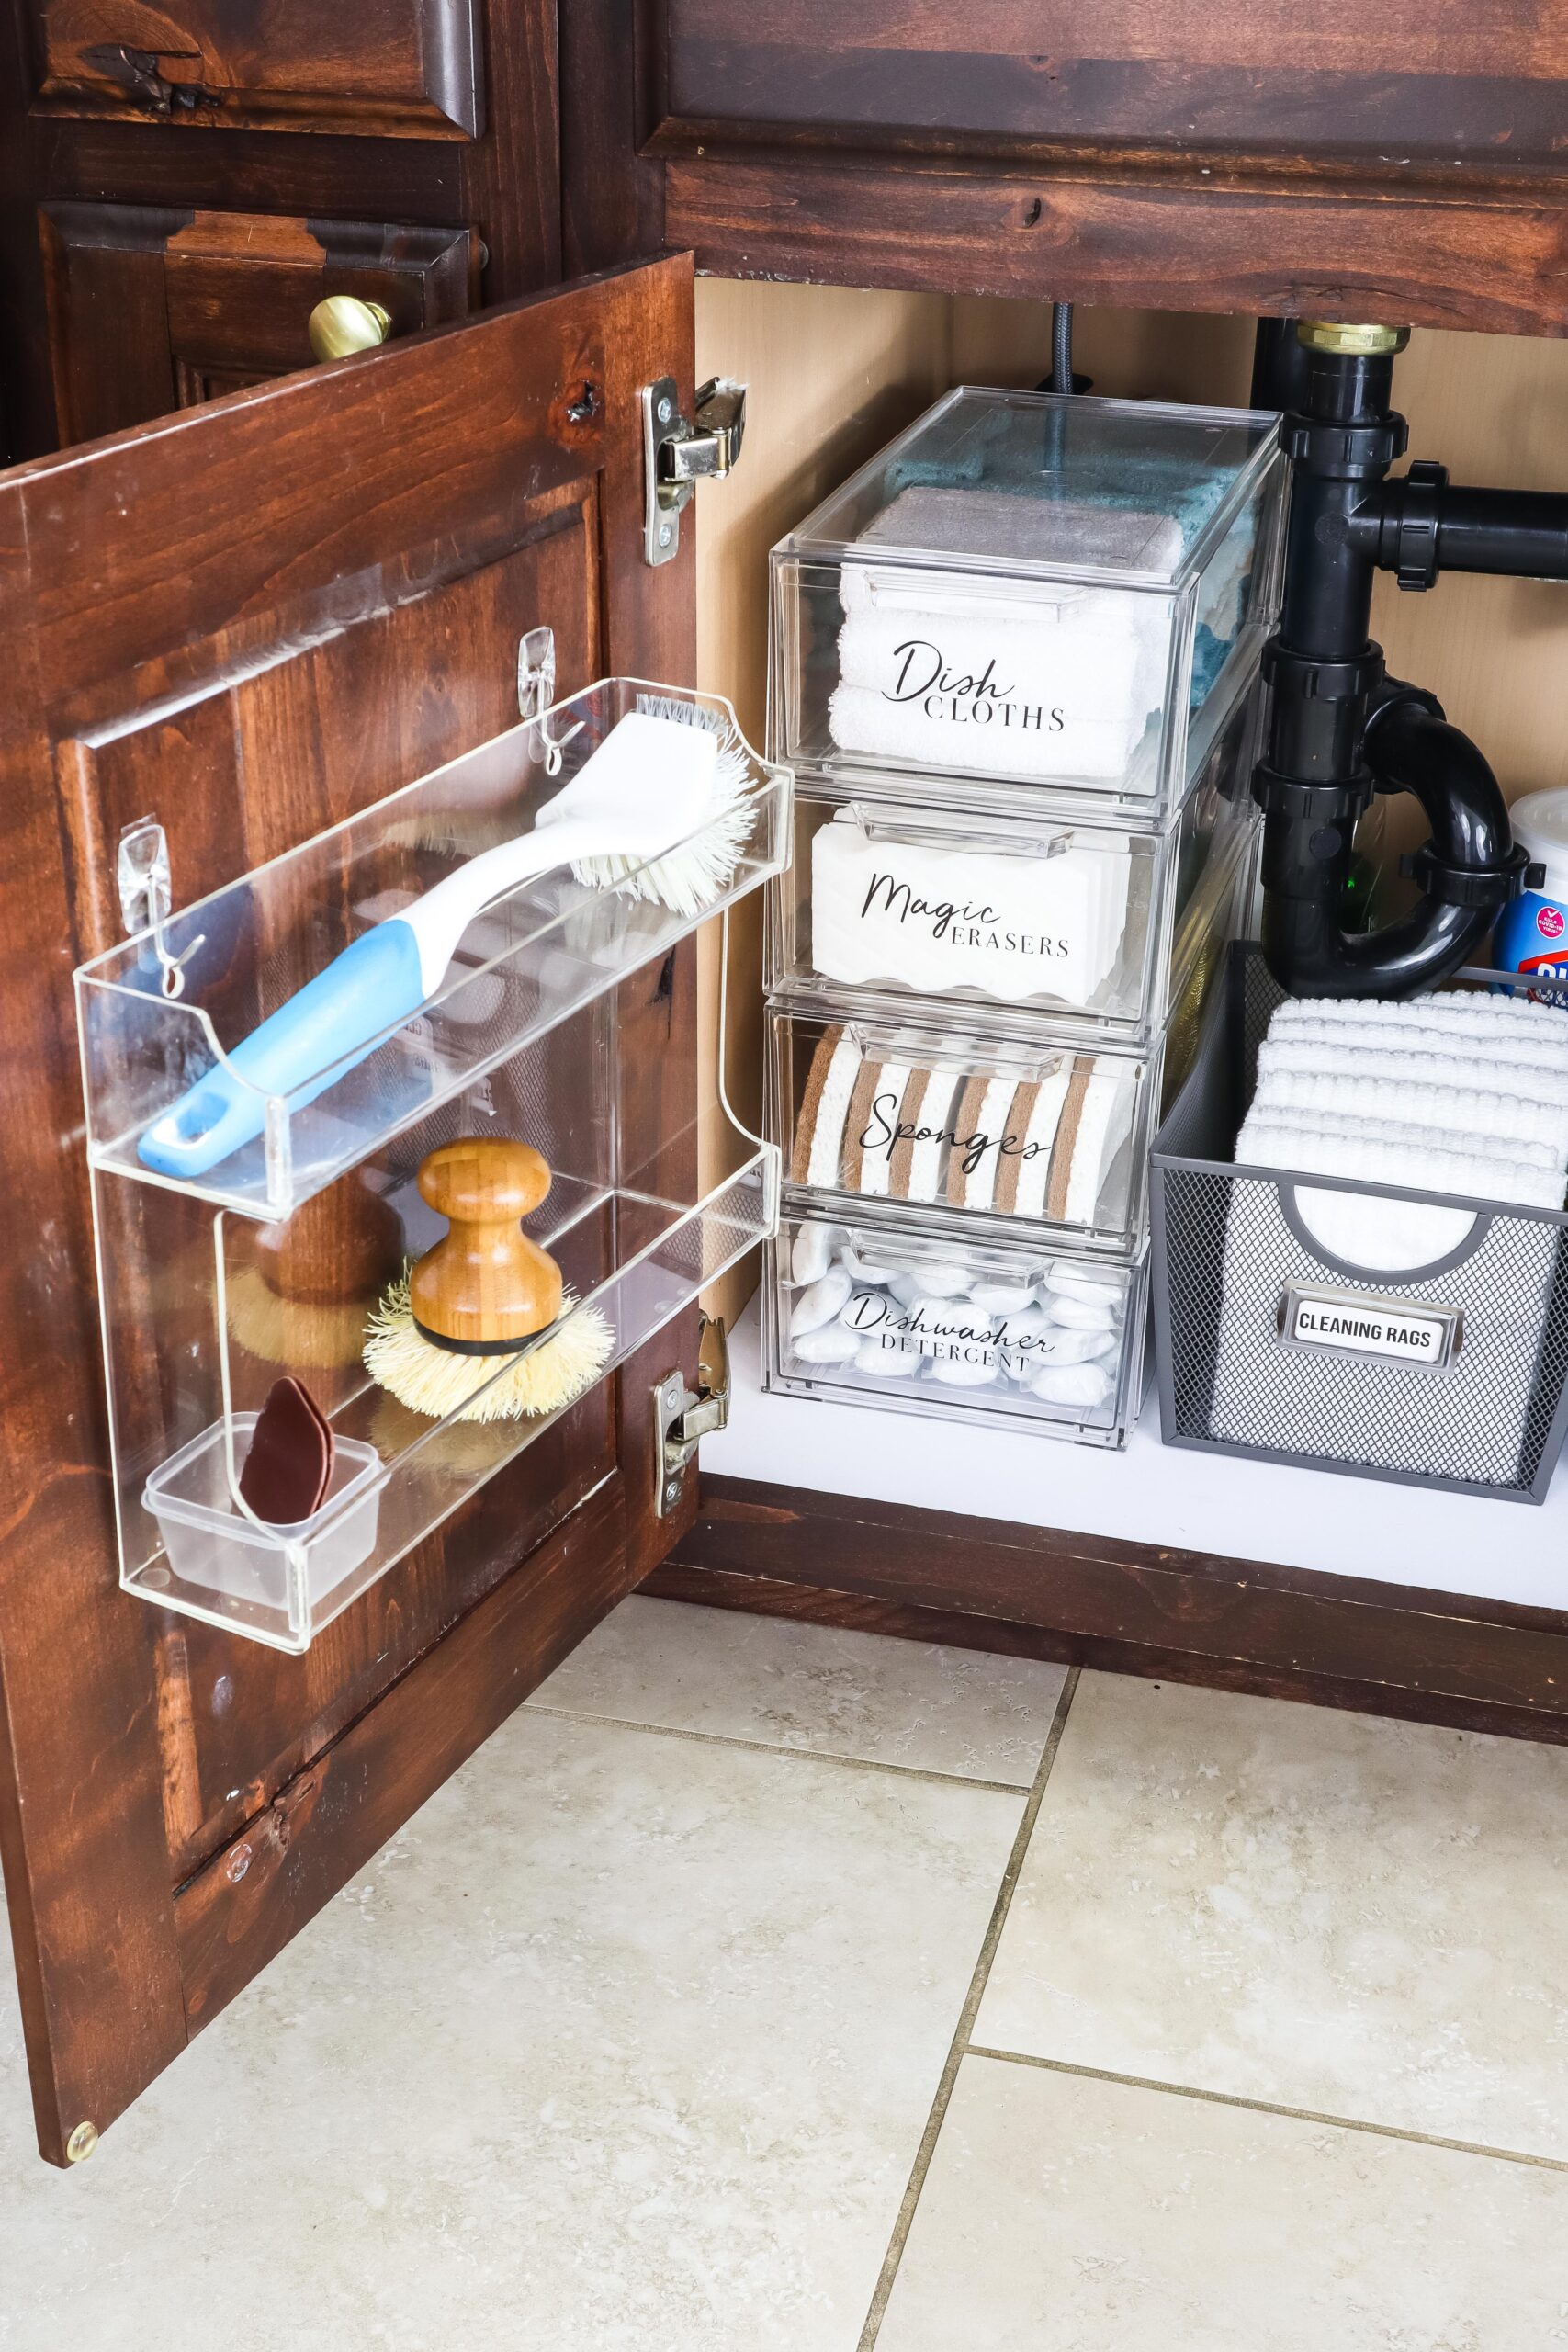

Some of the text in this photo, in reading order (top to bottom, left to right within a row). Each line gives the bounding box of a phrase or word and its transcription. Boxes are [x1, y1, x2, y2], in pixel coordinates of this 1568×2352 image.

[882, 640, 1015, 702] Dish
[924, 695, 1065, 732] CLOTHS
[862, 873, 1001, 939] Magic
[952, 926, 1070, 958] ERASERS
[859, 1094, 1052, 1174] Sponges
[844, 1292, 1055, 1353] Dishwasher
[1299, 1313, 1431, 1347] CLEANING RAGS
[881, 1333, 1030, 1373] DETERGENT
